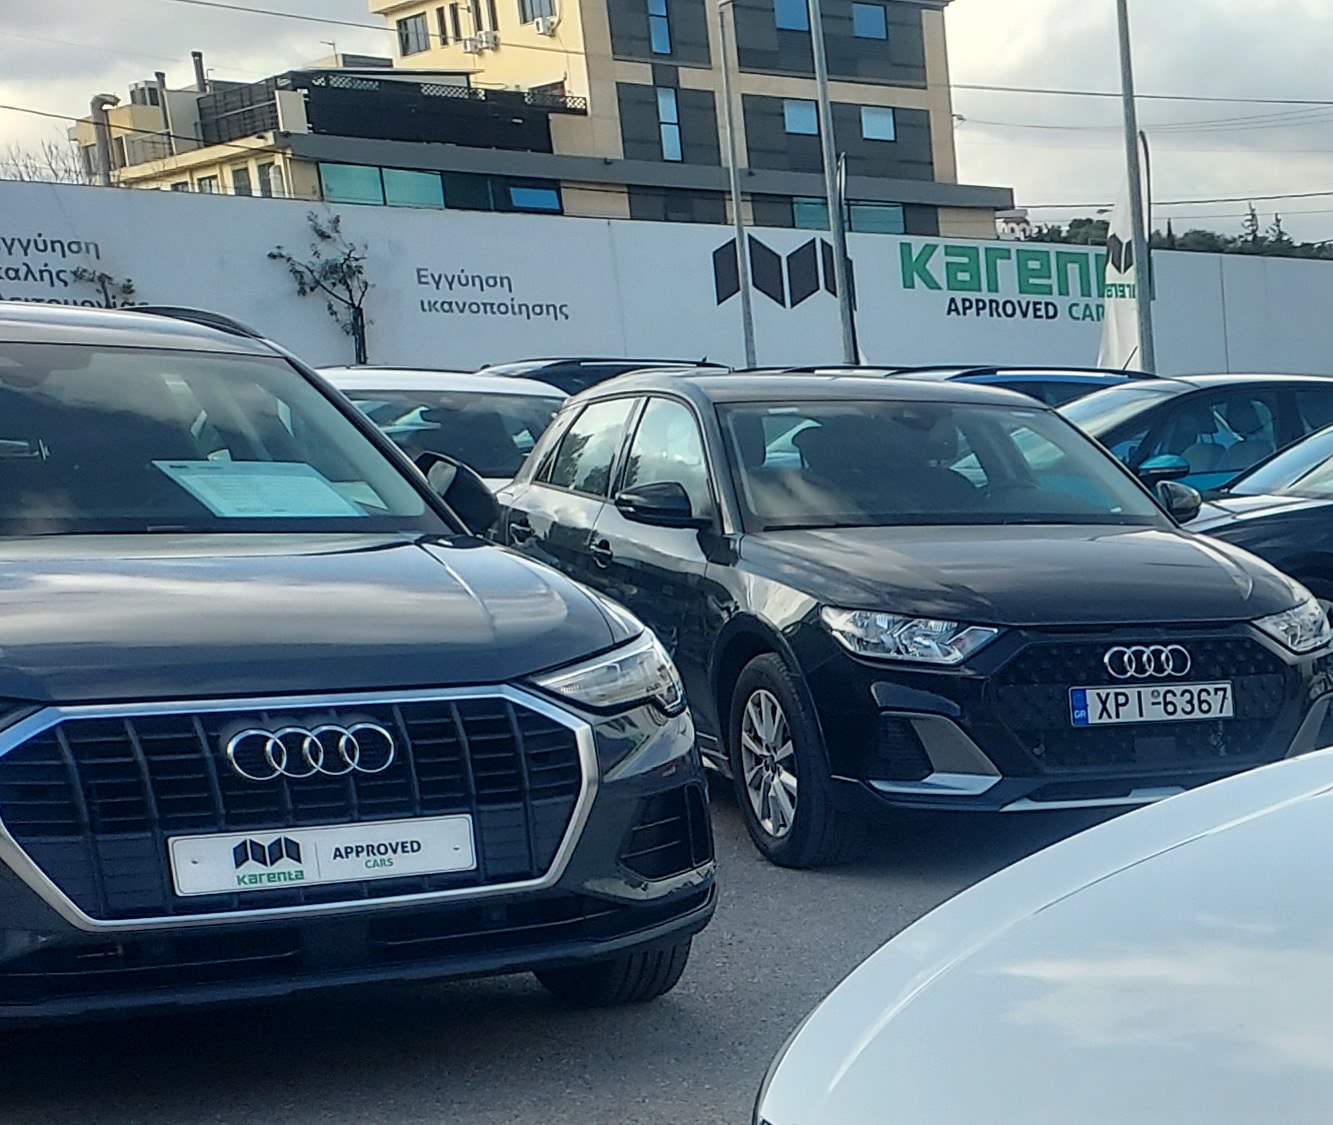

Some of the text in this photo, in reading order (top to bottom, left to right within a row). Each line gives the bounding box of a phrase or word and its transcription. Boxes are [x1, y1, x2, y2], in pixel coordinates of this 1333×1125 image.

[0, 233, 100, 260] γγύηση
[415, 267, 513, 293] Εγγύηση
[420, 297, 570, 321] ικανοποίησης
[946, 296, 1059, 320] APPROVED
[1074, 709, 1087, 719] GR
[332, 839, 422, 861] APPROVED
[364, 857, 394, 869] CARS
